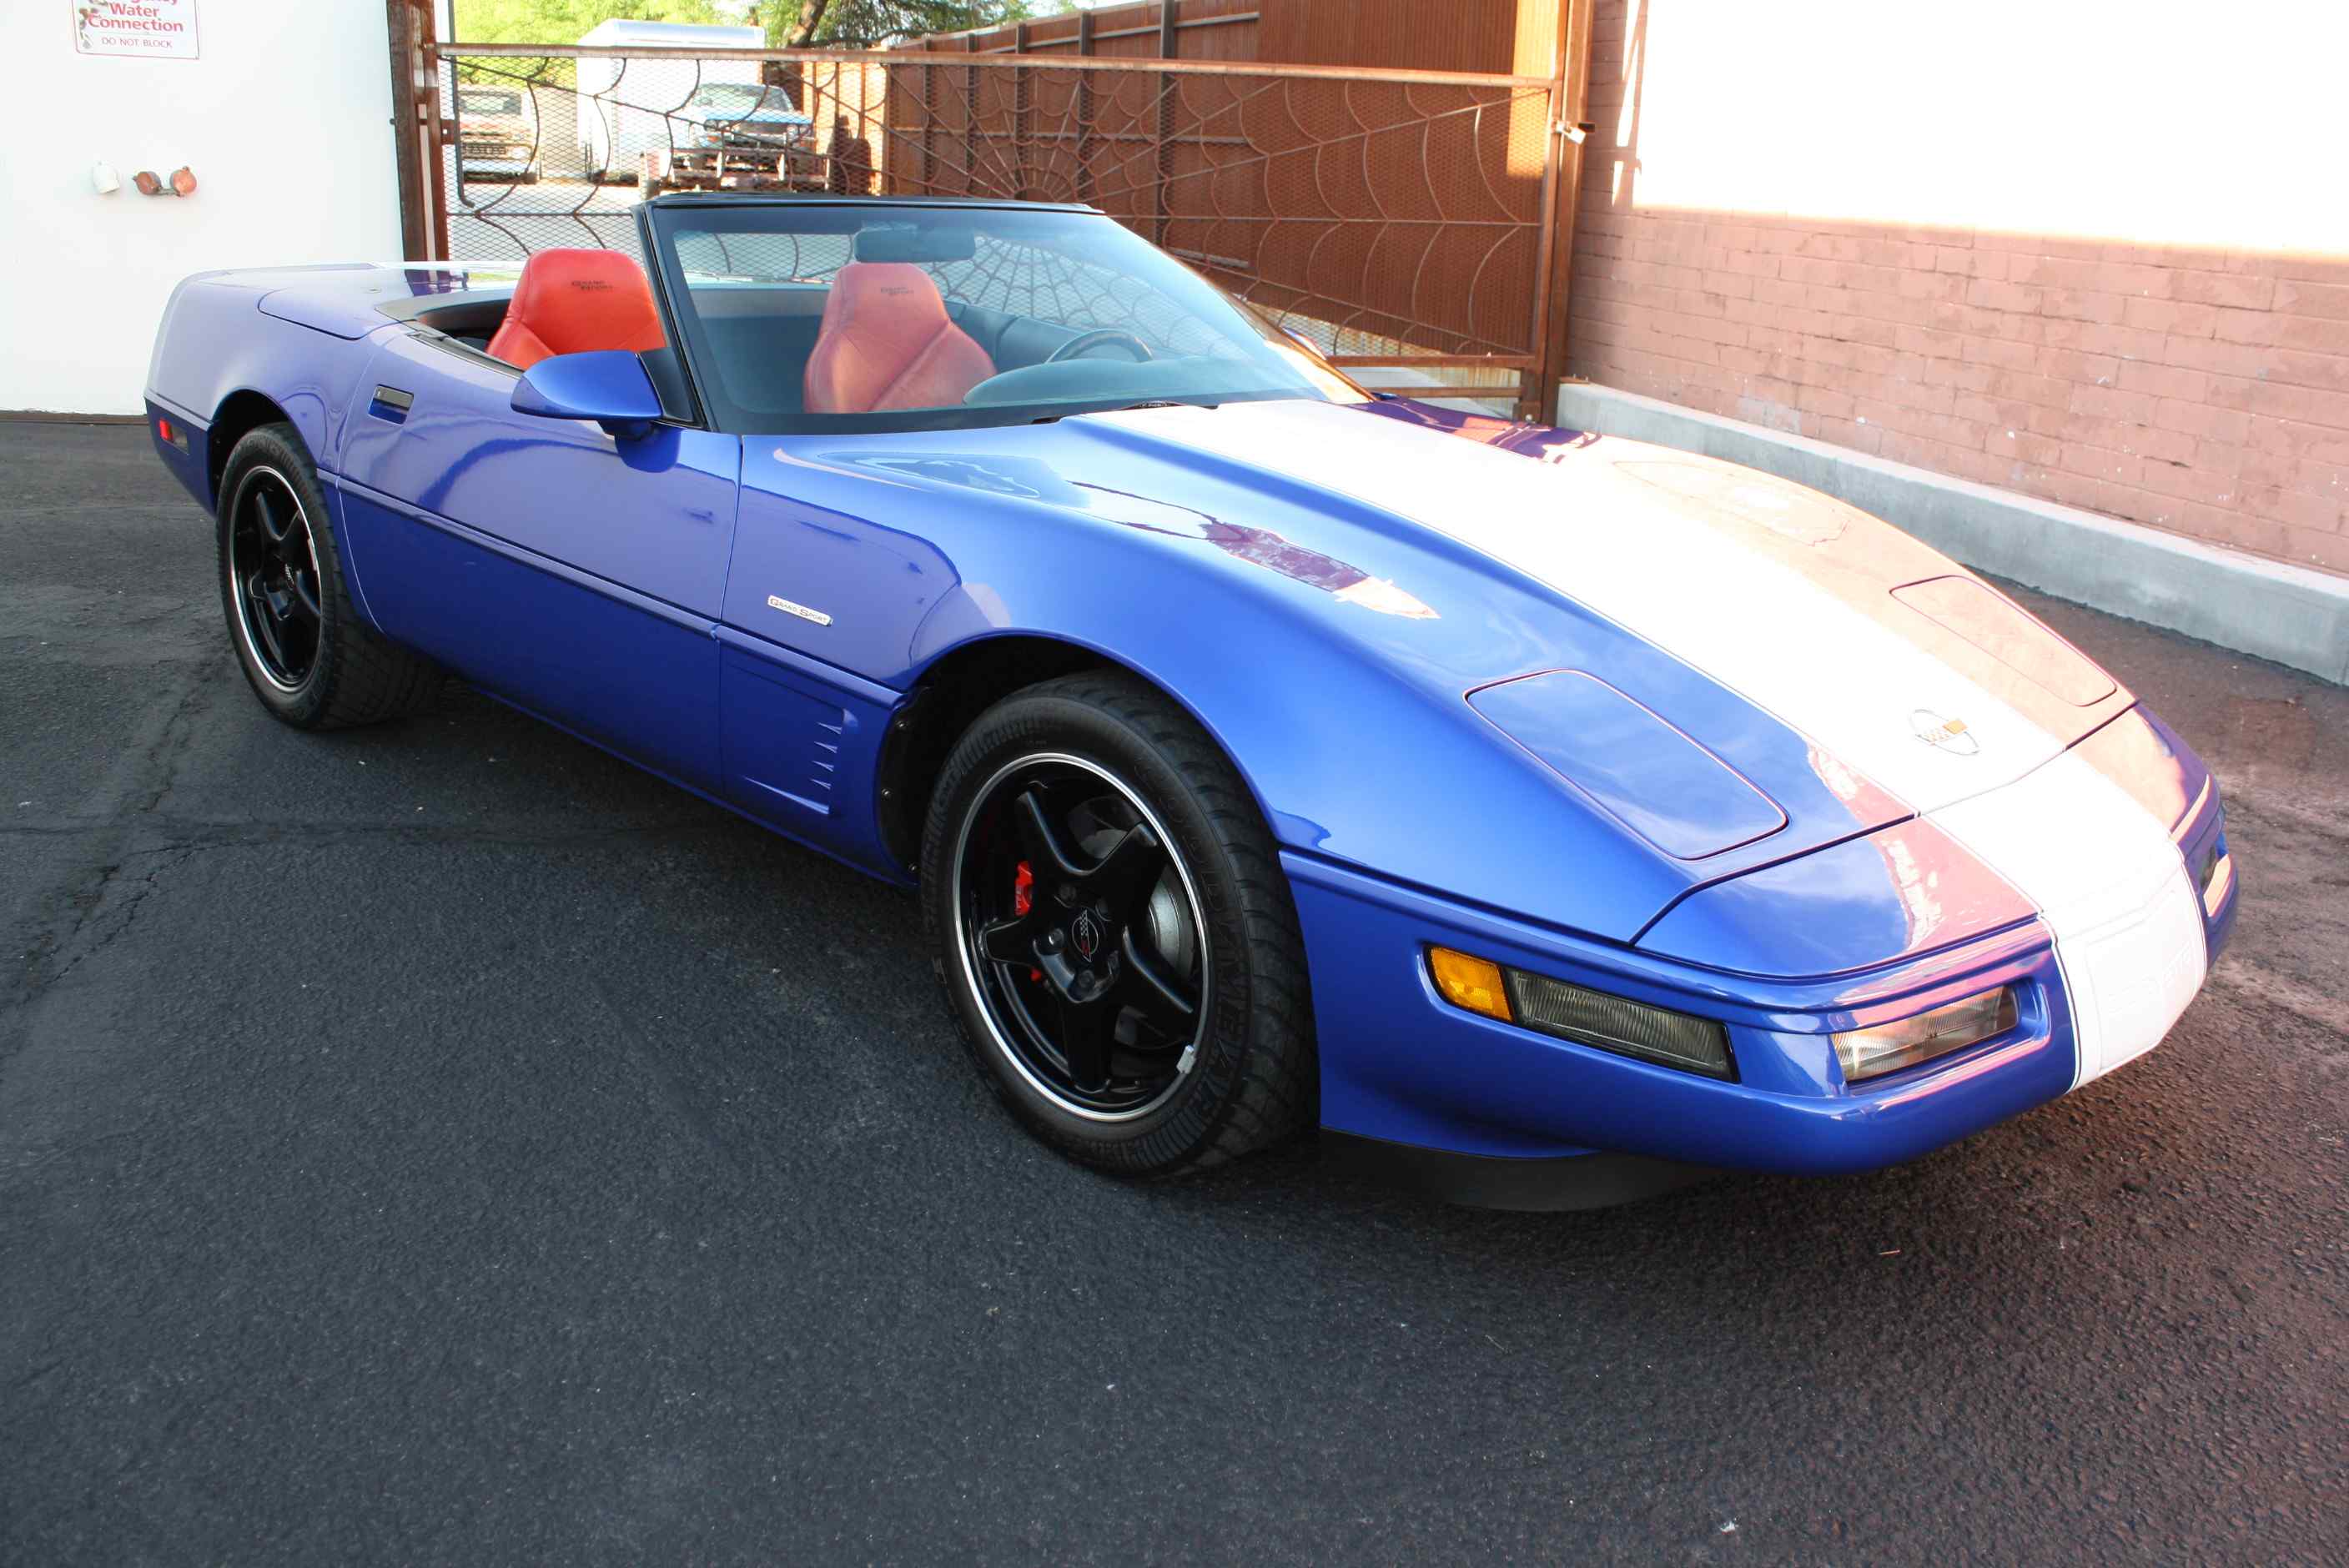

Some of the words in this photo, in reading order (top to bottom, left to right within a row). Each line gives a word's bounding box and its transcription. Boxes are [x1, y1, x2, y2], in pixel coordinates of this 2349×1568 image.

[109, 3, 160, 18] Water
[88, 14, 184, 33] Connection
[101, 37, 116, 46] DO
[119, 38, 138, 47] NOT
[143, 39, 173, 48] BLOCK
